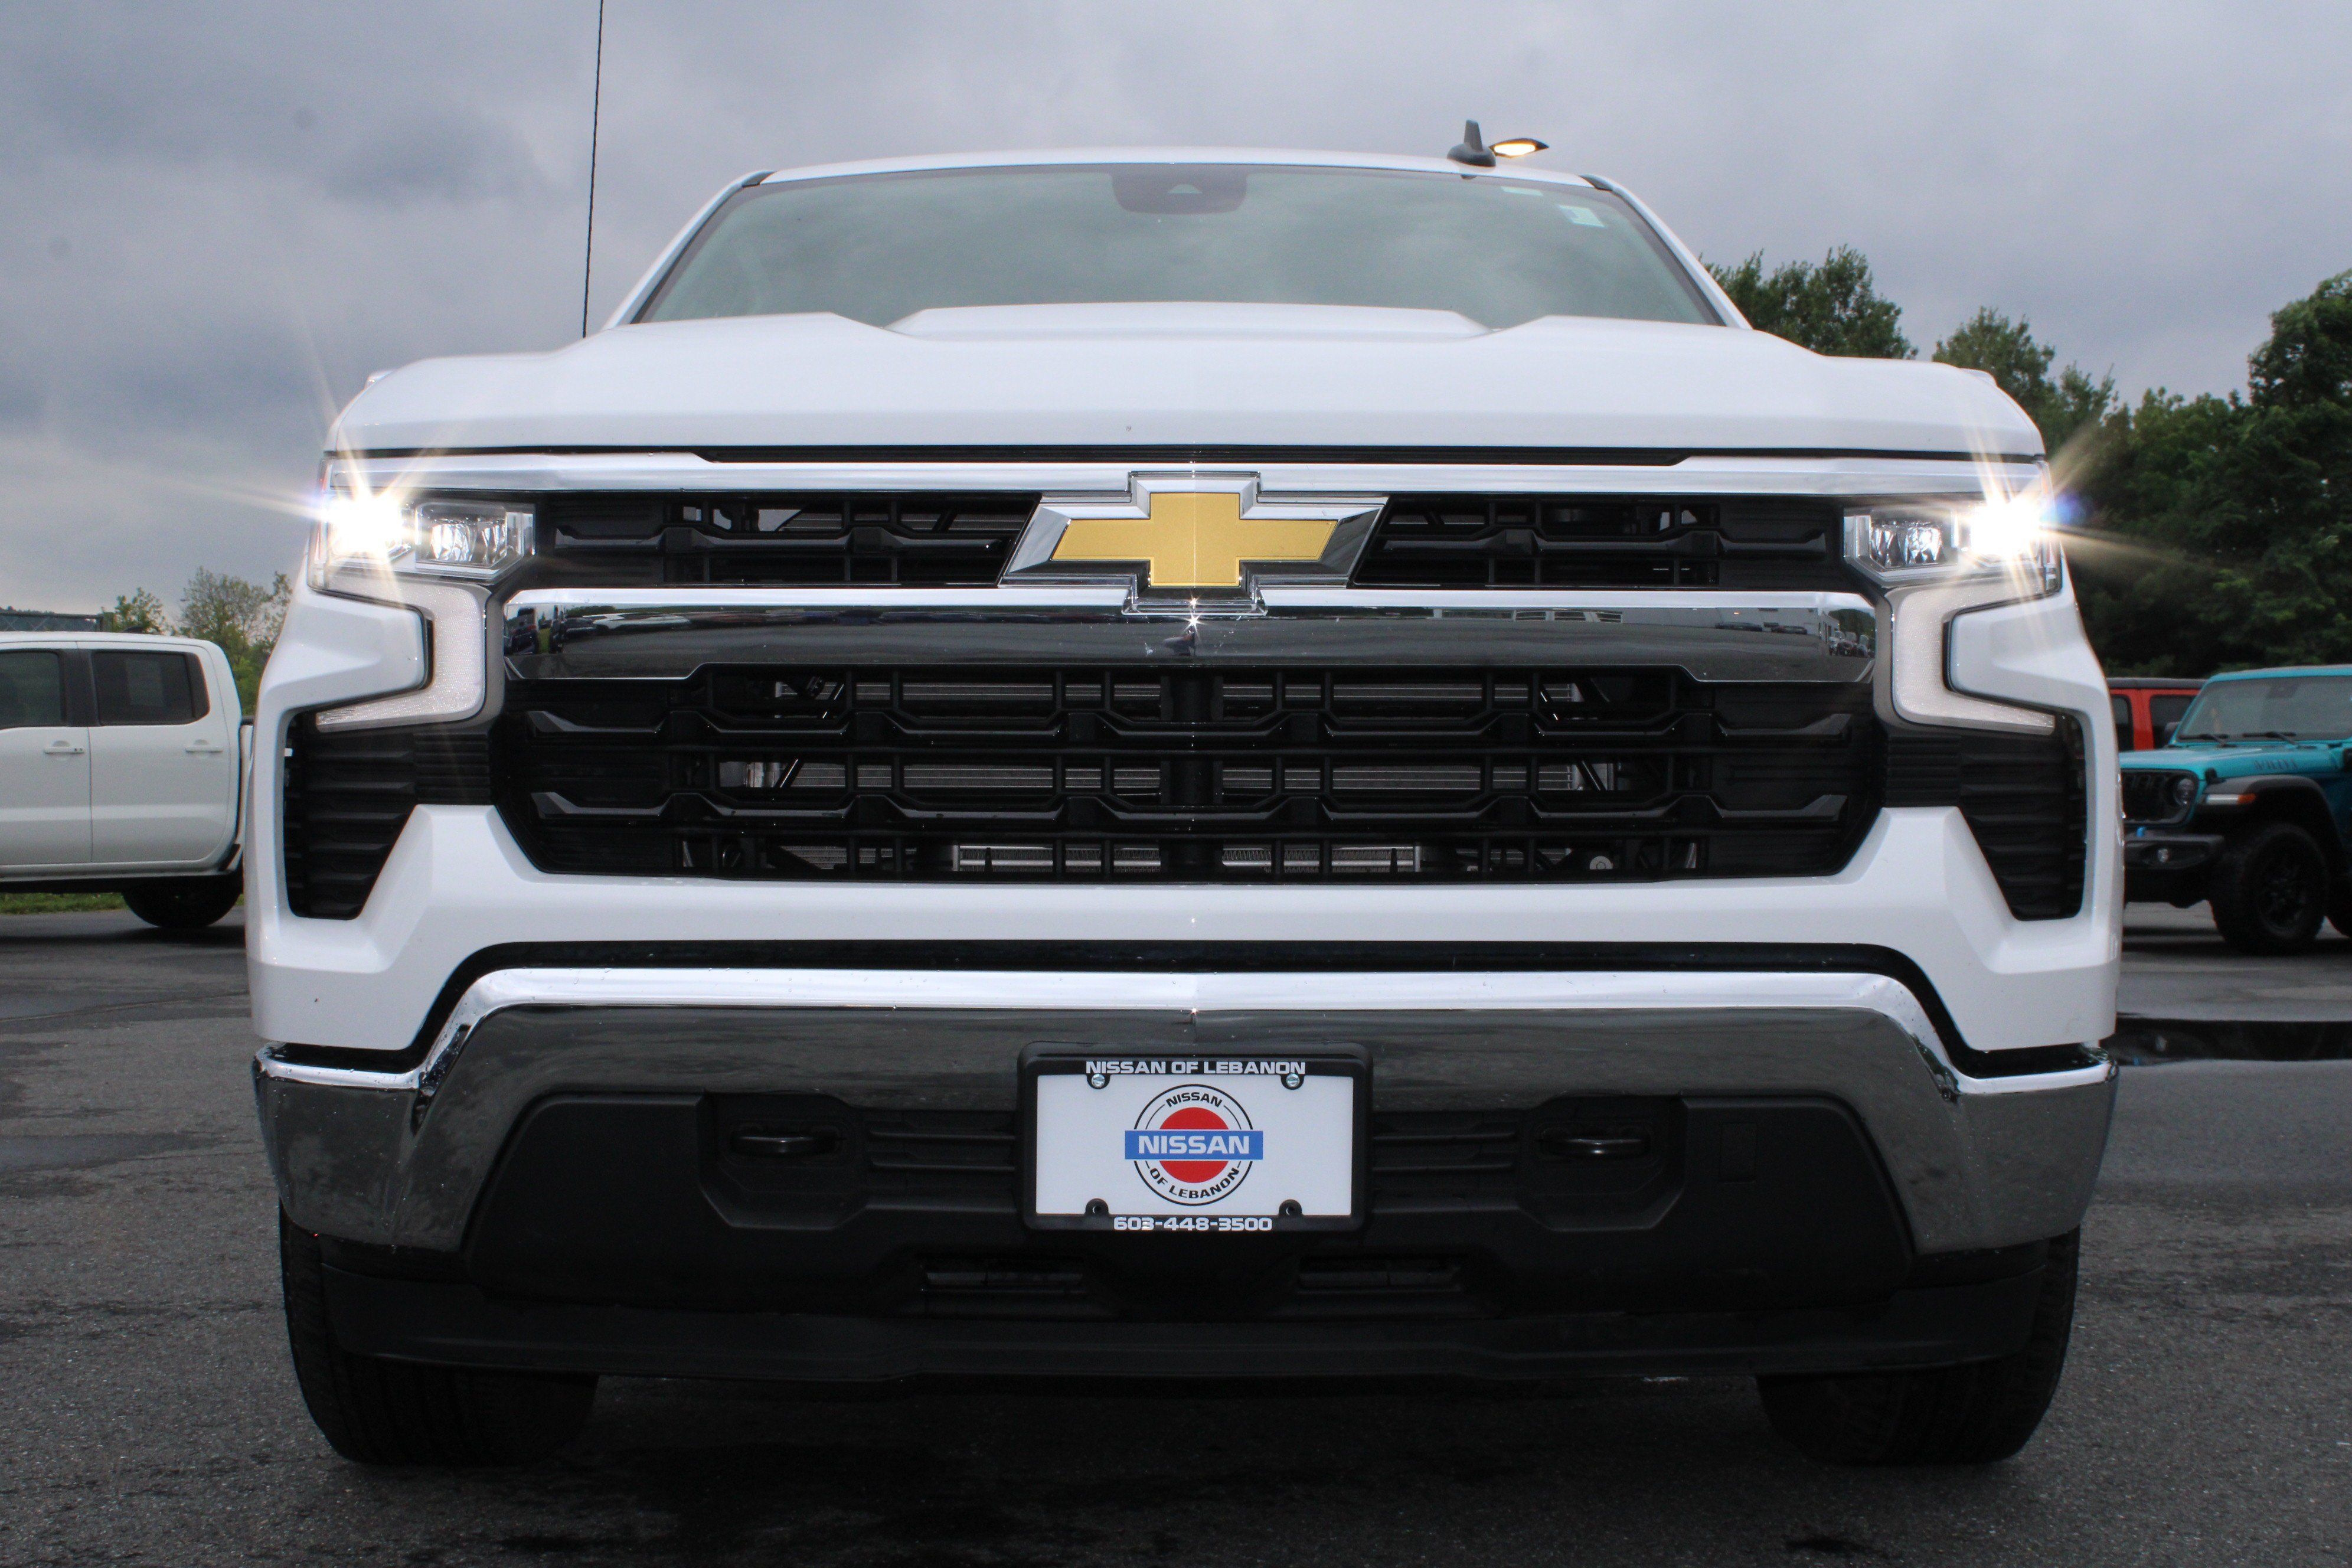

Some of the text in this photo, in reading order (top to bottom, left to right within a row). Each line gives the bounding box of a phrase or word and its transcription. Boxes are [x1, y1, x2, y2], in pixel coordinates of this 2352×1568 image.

[1086, 1061, 1306, 1074] NISSAN OF LEBANON
[1165, 1092, 1223, 1108] NISSAN
[1138, 1135, 1249, 1154] NISSAN
[1149, 1167, 1240, 1199] OF LEBANON
[1113, 1217, 1273, 1231] 603-448-3500
